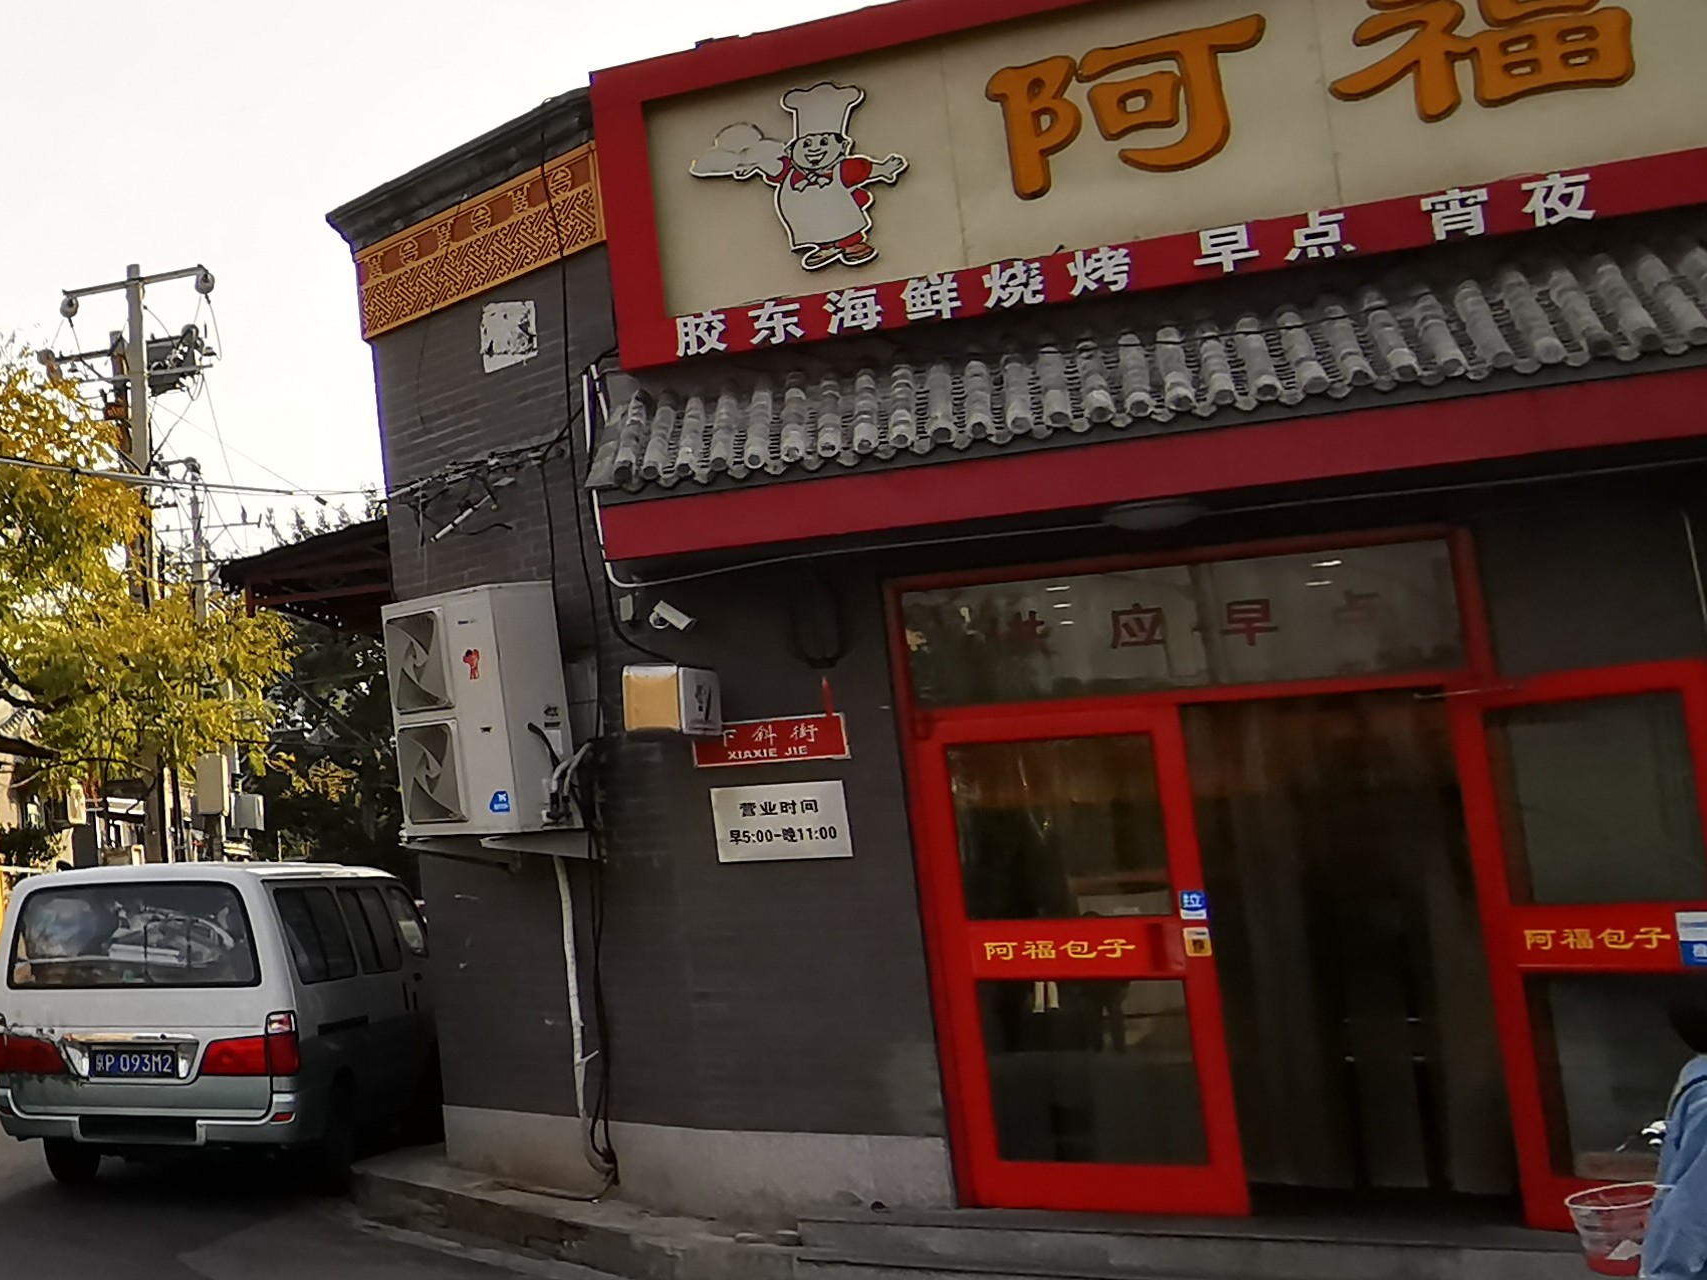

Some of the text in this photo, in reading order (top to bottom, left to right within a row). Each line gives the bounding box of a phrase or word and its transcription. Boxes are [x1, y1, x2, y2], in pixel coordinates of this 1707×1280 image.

[675, 171, 1597, 360] 胶东海鲜烧烤 早点 宵夜
[721, 723, 819, 748] 下斜街
[727, 745, 808, 760] XIAXIE JIE
[739, 798, 819, 818] 营业时间
[983, 938, 1136, 961] 阿福包子
[1523, 926, 1672, 951] 阿福包子
